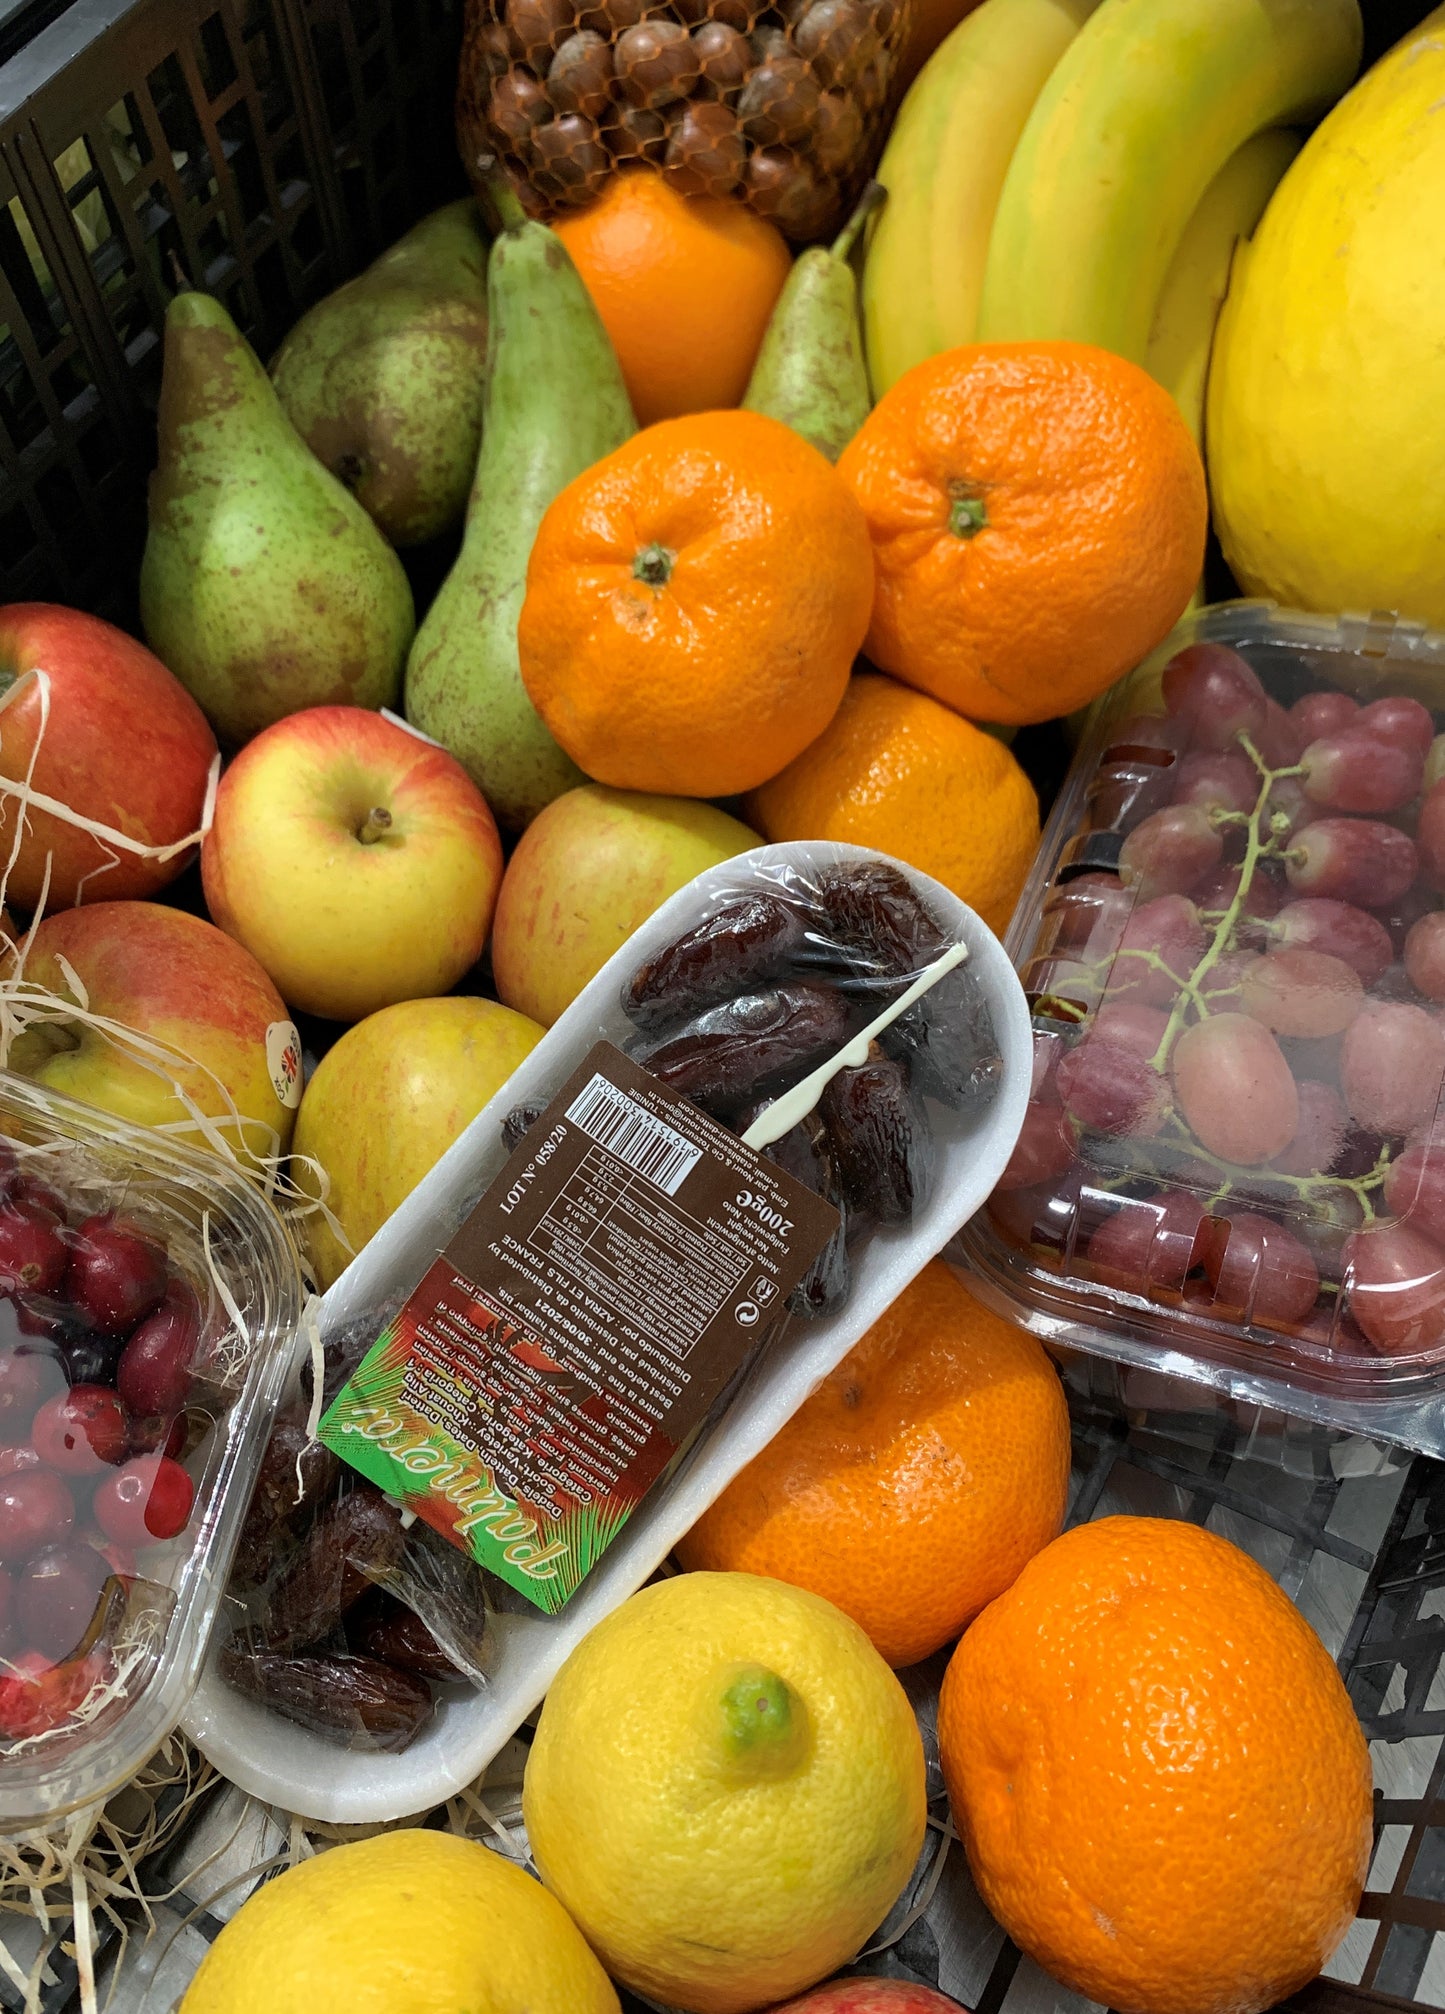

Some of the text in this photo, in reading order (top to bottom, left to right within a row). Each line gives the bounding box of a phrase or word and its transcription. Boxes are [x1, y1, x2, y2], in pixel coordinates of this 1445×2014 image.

[627, 1087, 658, 1113] TUNISIE
[664, 1112, 710, 1151] Tozeur/Tunis
[677, 1100, 759, 1163] www.nouri-dattes.com
[711, 1147, 724, 1161] Cie
[499, 1179, 526, 1214] LOT
[534, 1124, 567, 1165] 058/20
[602, 1171, 615, 1182] 2,3
[731, 1163, 754, 1182] Nouri
[752, 1166, 779, 1188] e-mail:
[596, 1180, 608, 1191] 9,3
[753, 1179, 769, 1191] par
[588, 1191, 604, 1204] 64,7
[722, 1200, 742, 1219] Neto
[769, 1189, 788, 1208] Emb.
[541, 1218, 554, 1231] kcal
[726, 1217, 769, 1253] Net weight
[551, 1238, 566, 1253] 100g
[605, 1241, 624, 1259] which
[619, 1196, 734, 1286] Fibres alimentaires Dietary Fibre
[638, 1235, 659, 1253] sugars
[703, 1231, 747, 1267] Sel Salt Sele
[706, 1216, 779, 1274] Netto afvulgewicht
[565, 1250, 577, 1260] per
[574, 1257, 590, 1271] medi
[606, 1219, 718, 1306] Glucides Carbohydrates Carboidrati
[658, 1250, 678, 1267] which
[684, 1231, 740, 1276] Protéines Protein
[607, 1233, 713, 1314] saturated di cui acidi grassi saturi
[614, 1259, 635, 1277] Grassi
[682, 1259, 726, 1294] di cui zuccheri
[452, 1276, 474, 1292] pref
[616, 1274, 642, 1297] Energia
[638, 1276, 650, 1288] Fat
[656, 1280, 672, 1294] gras
[705, 1285, 722, 1300] dont
[501, 1233, 691, 1383] Distribuido por AZRIA ET FILS FRANCE
[547, 1247, 682, 1355] Valeurs nutritionnelles pour 100g Nutritional
[617, 1291, 635, 1308] Valori
[644, 1295, 668, 1317] Energy
[670, 1291, 692, 1309] acides
[487, 1241, 682, 1396] Distribué par, Distribuito da, Distributed by
[643, 1311, 656, 1323] 100
[675, 1304, 703, 1328] Matières
[690, 1306, 707, 1321] dont
[523, 1328, 537, 1342] Da
[655, 1320, 669, 1332] per
[667, 1328, 688, 1347] values
[415, 1324, 450, 1353] Zutaten
[435, 1319, 485, 1359] Ingredients
[498, 1285, 664, 1420] entre la fine Mindestens haltbar bis,
[534, 1298, 673, 1409] Best before end 30/06/2021
[435, 1299, 607, 1434] glucose sirup Ingredienti sciroppo di
[455, 1354, 486, 1380] siroop
[556, 1357, 603, 1396] houdbaar
[424, 1369, 477, 1413] Categoria
[486, 1376, 522, 1408] glucose
[605, 1394, 652, 1434] Tenminste
[480, 1409, 534, 1459] Kategorie,
[606, 1412, 646, 1443] glucosio
[400, 1387, 563, 1518] Dadels, Datteln, Dates, Datteri
[476, 1427, 520, 1468] Varietey
[539, 1438, 565, 1461] From
[519, 1463, 556, 1494] Soort,
[536, 1454, 592, 1505] Catégorie,
